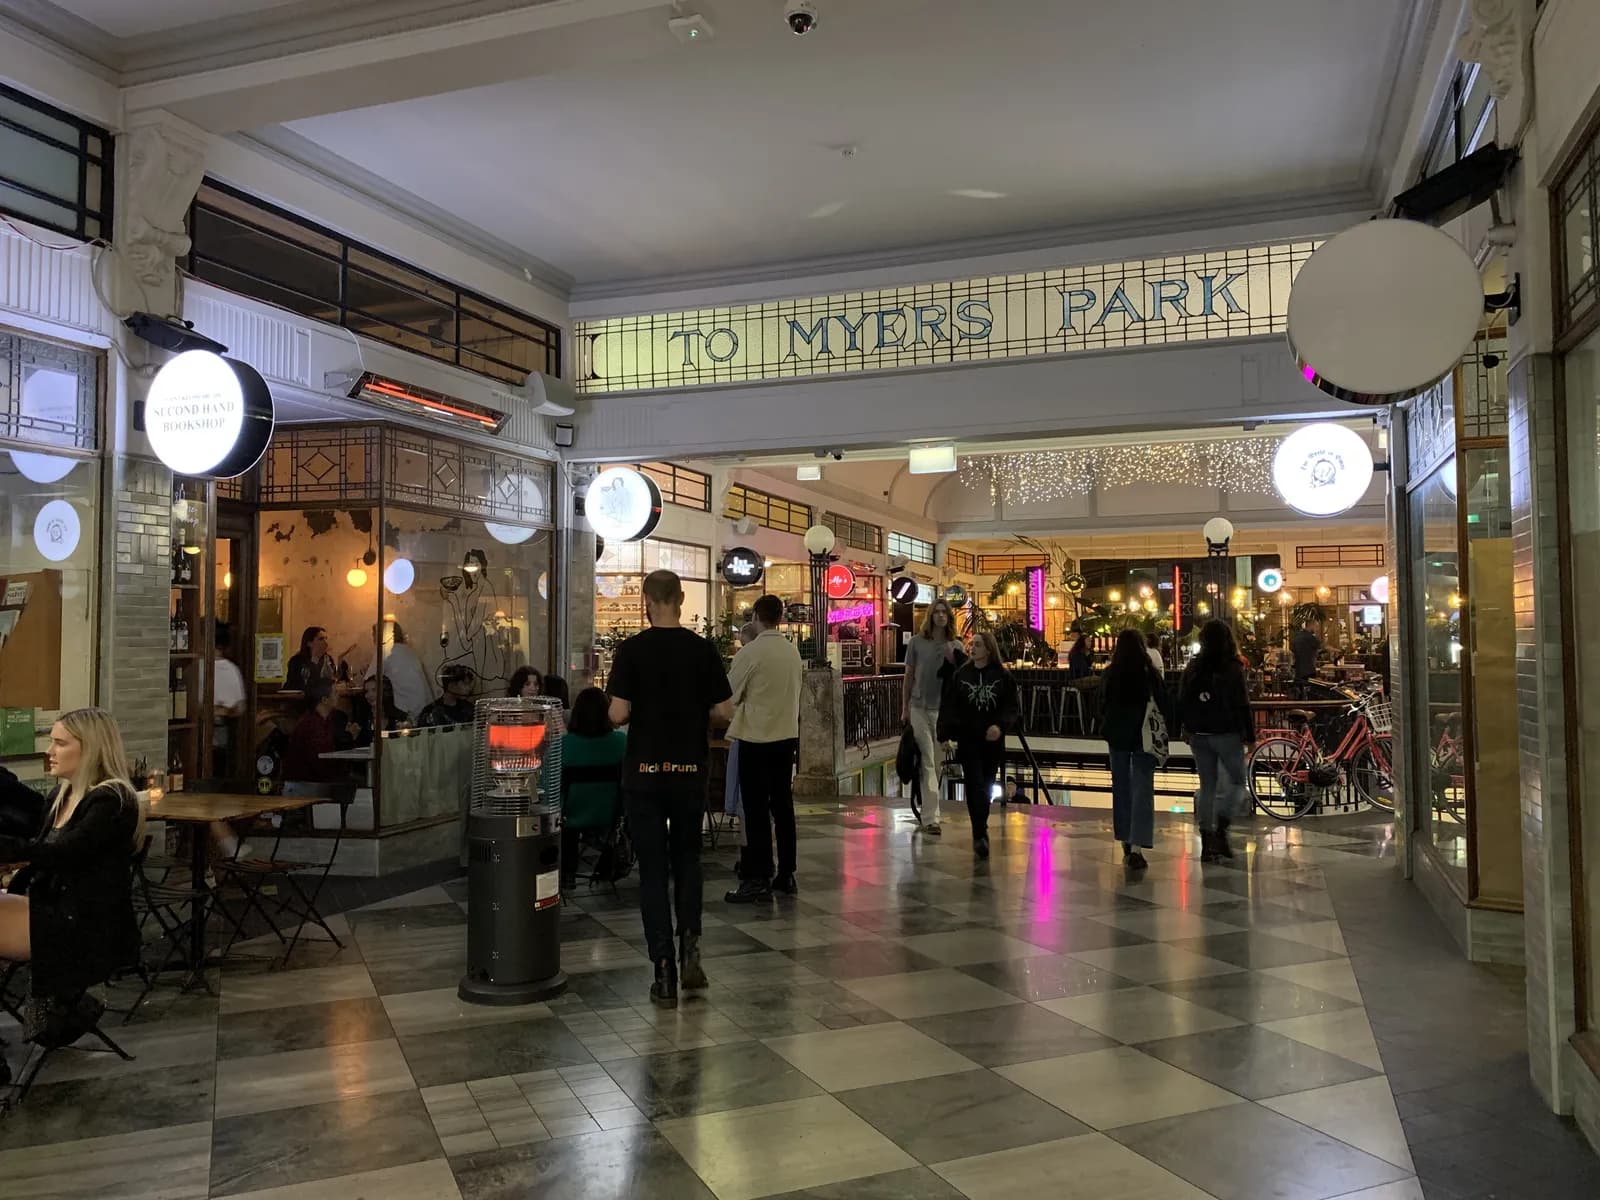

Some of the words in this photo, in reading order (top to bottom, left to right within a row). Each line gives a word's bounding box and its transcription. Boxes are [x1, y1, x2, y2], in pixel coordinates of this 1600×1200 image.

[671, 327, 739, 366] TO
[787, 300, 994, 358] MYERS
[1061, 272, 1246, 332] PARK
[153, 404, 200, 417] SECOND
[202, 401, 235, 415] HAND
[163, 418, 225, 433] BOOKSHOP
[639, 761, 660, 774] Dick
[662, 761, 698, 773] Bruna
